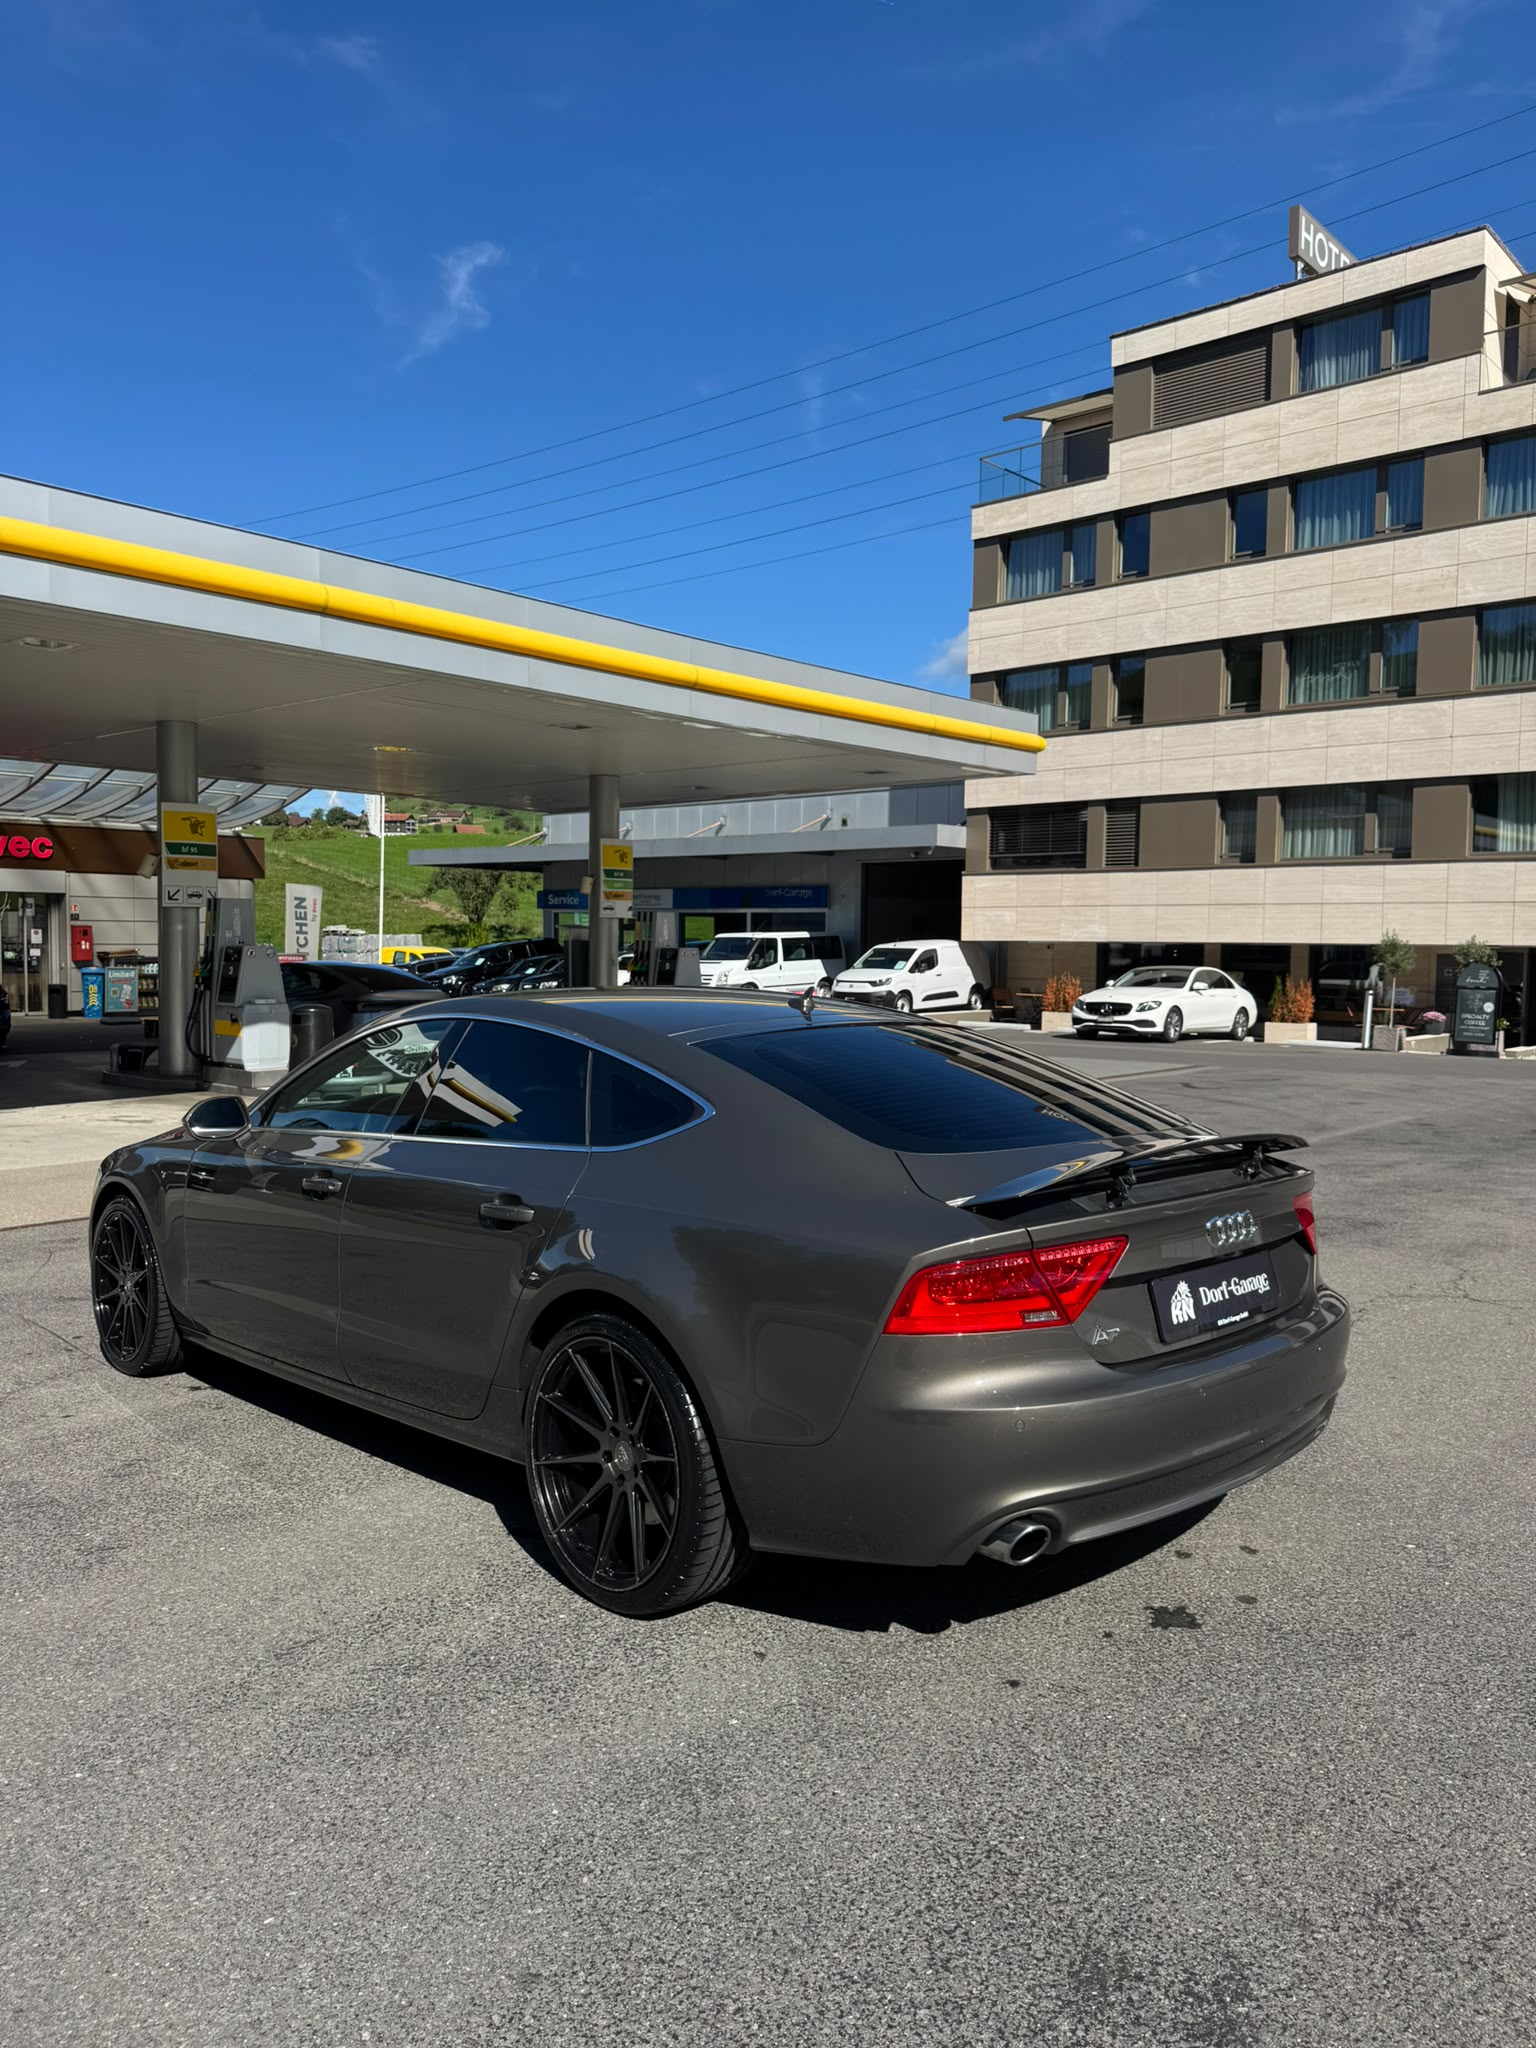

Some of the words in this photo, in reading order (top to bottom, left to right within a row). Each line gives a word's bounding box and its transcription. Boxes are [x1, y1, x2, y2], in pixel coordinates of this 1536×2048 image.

[548, 894, 579, 905] Service
[108, 970, 135, 978] Limited
[1199, 1273, 1270, 1305] Dorf-Garage
[1092, 1325, 1120, 1345] A7
